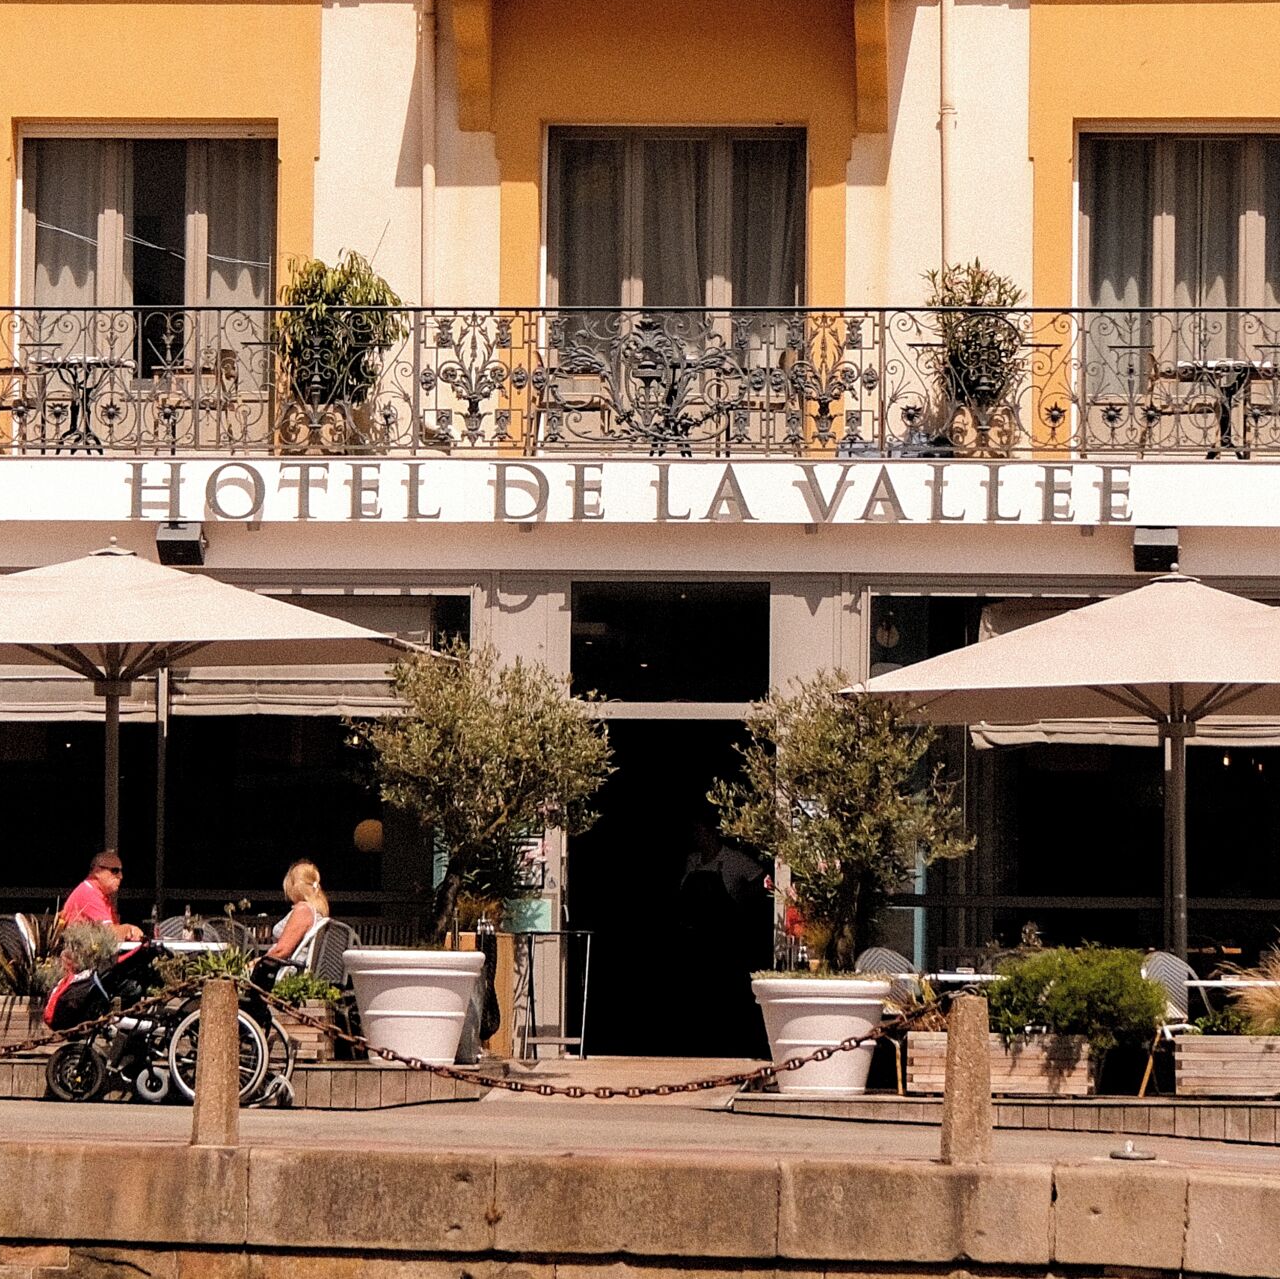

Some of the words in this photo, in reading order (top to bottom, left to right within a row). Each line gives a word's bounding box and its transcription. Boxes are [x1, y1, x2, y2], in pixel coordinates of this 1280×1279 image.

[128, 462, 442, 520] HOTEL
[495, 463, 606, 520] DE
[653, 463, 759, 521] LA
[794, 463, 1135, 523] VALLEE
